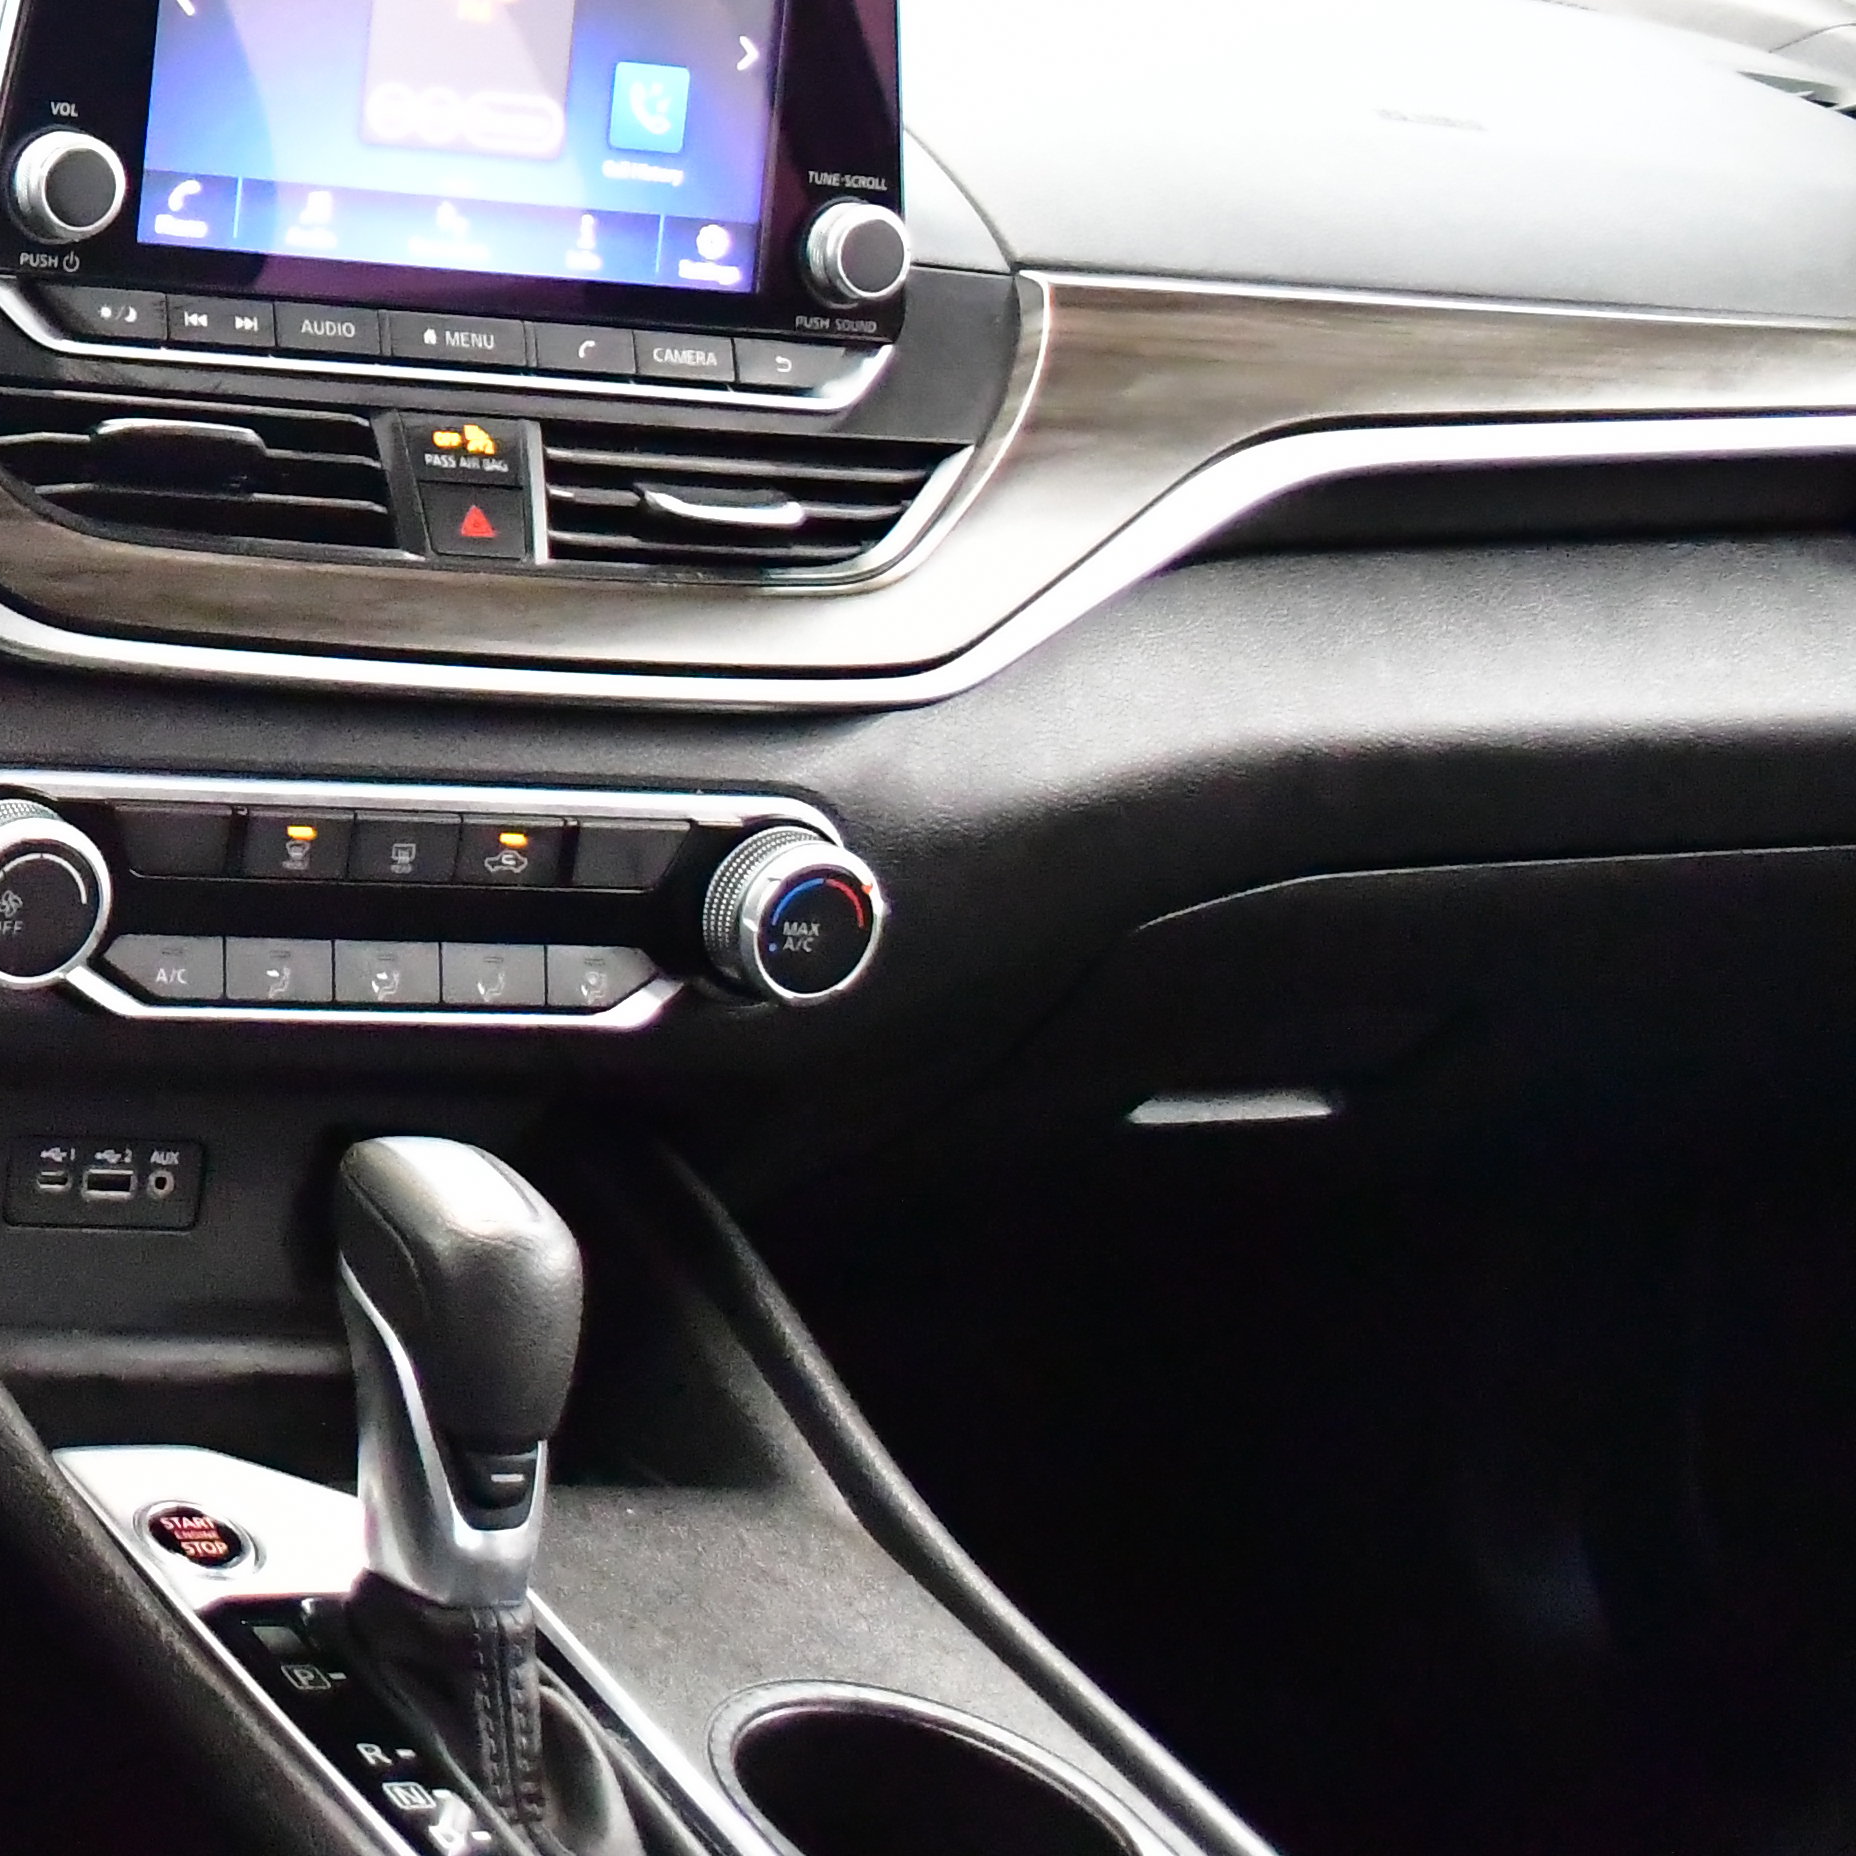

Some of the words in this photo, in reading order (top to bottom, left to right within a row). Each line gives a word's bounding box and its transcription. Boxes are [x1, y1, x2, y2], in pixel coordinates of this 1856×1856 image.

[50, 101, 78, 117] VOL
[20, 252, 58, 268] PUSH
[300, 317, 356, 339] AUDIO
[795, 315, 830, 330] PUSH
[835, 320, 877, 333] SOUND
[445, 328, 495, 350] MENU
[652, 346, 718, 367] CAMERA
[424, 453, 456, 469] PASS
[459, 455, 481, 470] AIR
[483, 458, 509, 473] BAG
[782, 921, 821, 937] MAX
[782, 936, 815, 953] A/C
[156, 968, 188, 985] A/C
[150, 1150, 180, 1165] AUX
[159, 1516, 216, 1531] START
[181, 1539, 229, 1557] STOP
[356, 1742, 393, 1766] R
